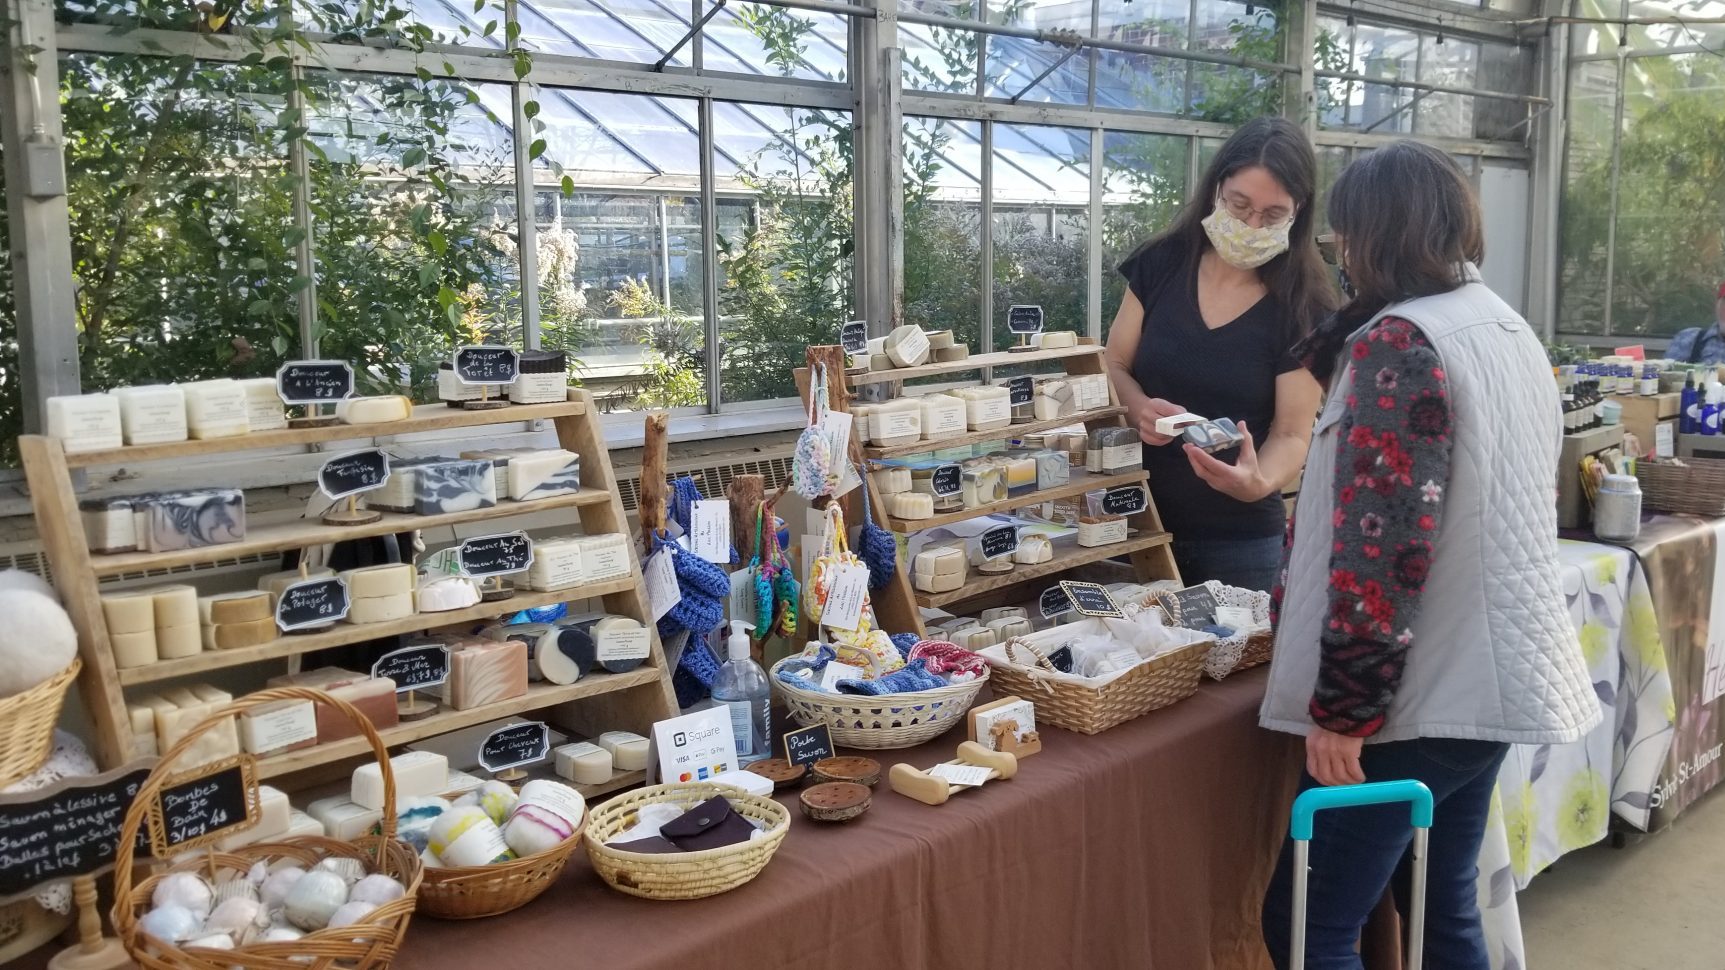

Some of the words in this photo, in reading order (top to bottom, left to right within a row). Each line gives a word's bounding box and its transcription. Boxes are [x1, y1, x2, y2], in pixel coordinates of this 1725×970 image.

[689, 726, 720, 742] Square
[763, 698, 771, 747] family
[676, 755, 690, 764] VISA
[1679, 742, 1723, 785] St-Amour
[165, 783, 219, 811] Bombes
